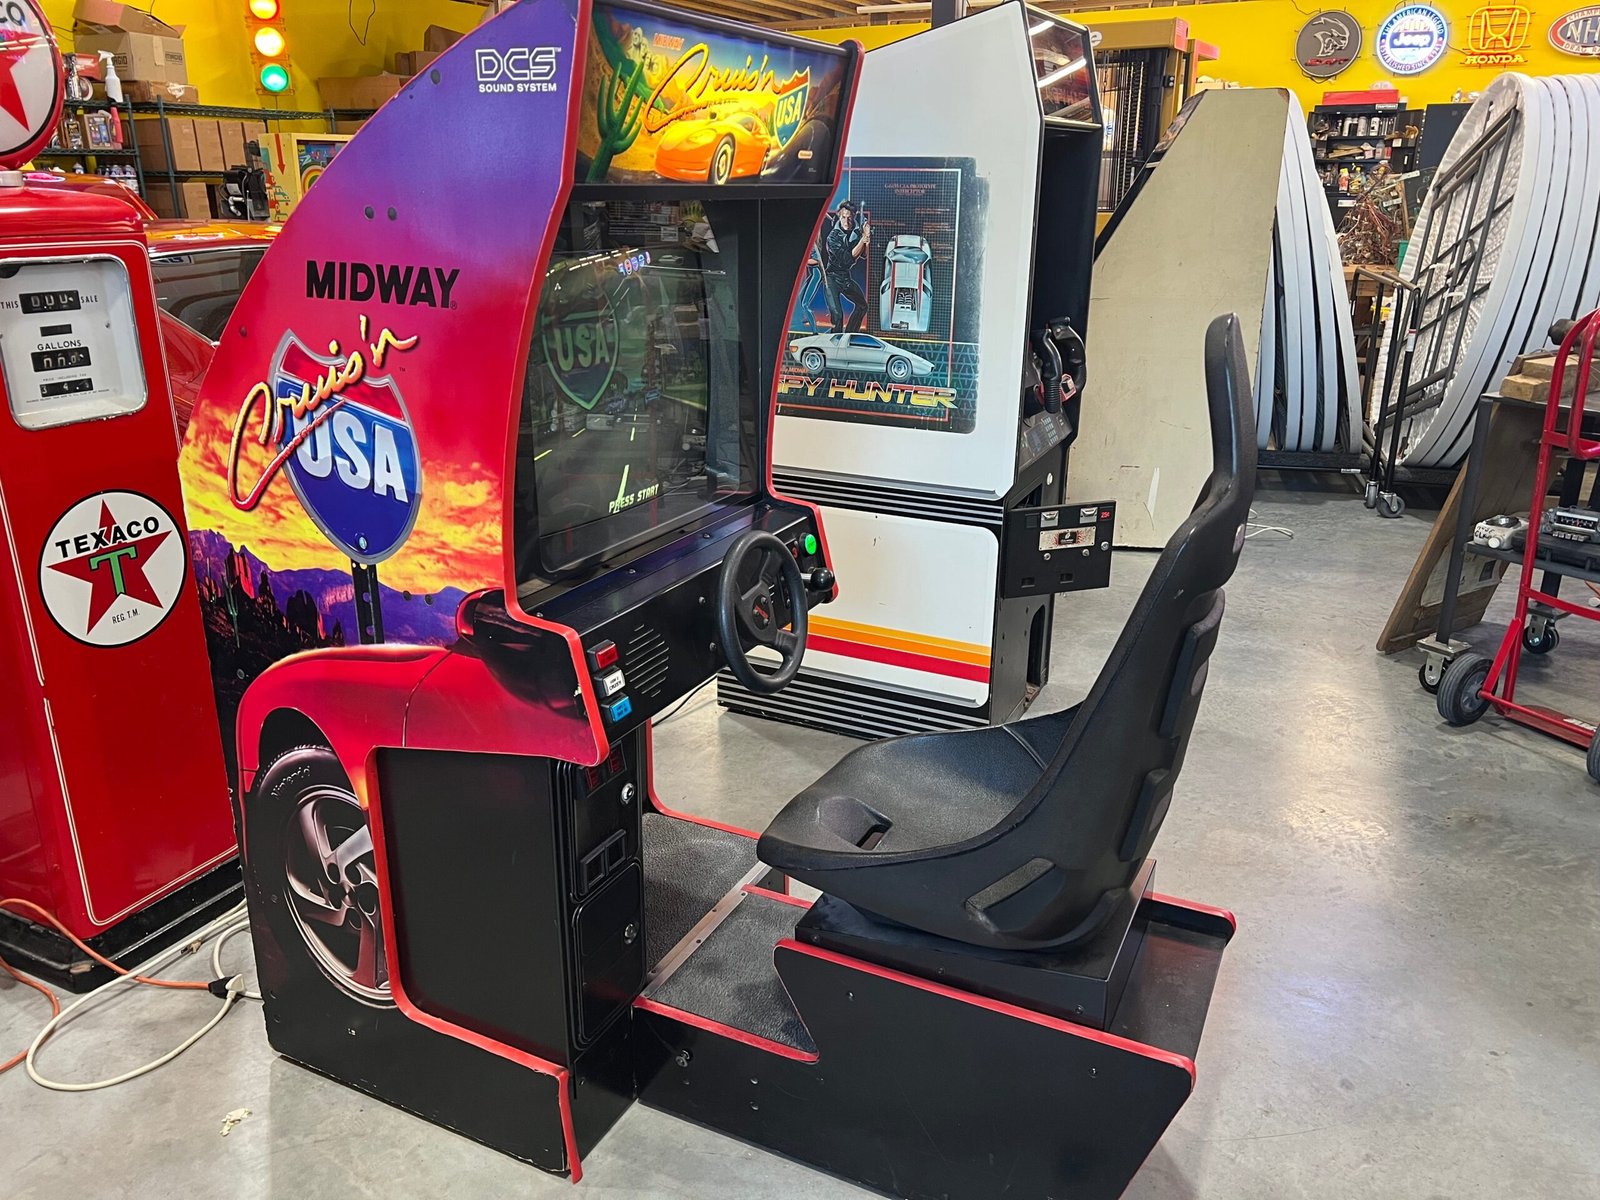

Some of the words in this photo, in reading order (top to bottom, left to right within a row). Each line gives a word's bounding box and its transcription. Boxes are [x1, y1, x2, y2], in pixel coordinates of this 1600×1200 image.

[1392, 8, 1427, 25] AMERICAN
[1393, 31, 1431, 48] Jeep
[1564, 43, 1587, 53] DRAG
[475, 47, 556, 81] DCS
[1464, 54, 1524, 65] HONDA
[478, 83, 515, 93] SOUND
[516, 83, 557, 92] SYSTEM
[644, 43, 786, 133] Cruis'n
[777, 91, 804, 127] USA
[80, 294, 98, 304] SALE
[305, 260, 460, 309] MIDWAY
[1, 300, 19, 310] THIS
[37, 339, 82, 351] GALLONS
[553, 322, 610, 371] USA
[828, 378, 959, 410] HUNTER
[227, 313, 418, 512] Cruis'n
[290, 401, 409, 504] USA
[608, 493, 635, 514] PRESS
[637, 483, 660, 502] START
[55, 516, 160, 558] TEXACO
